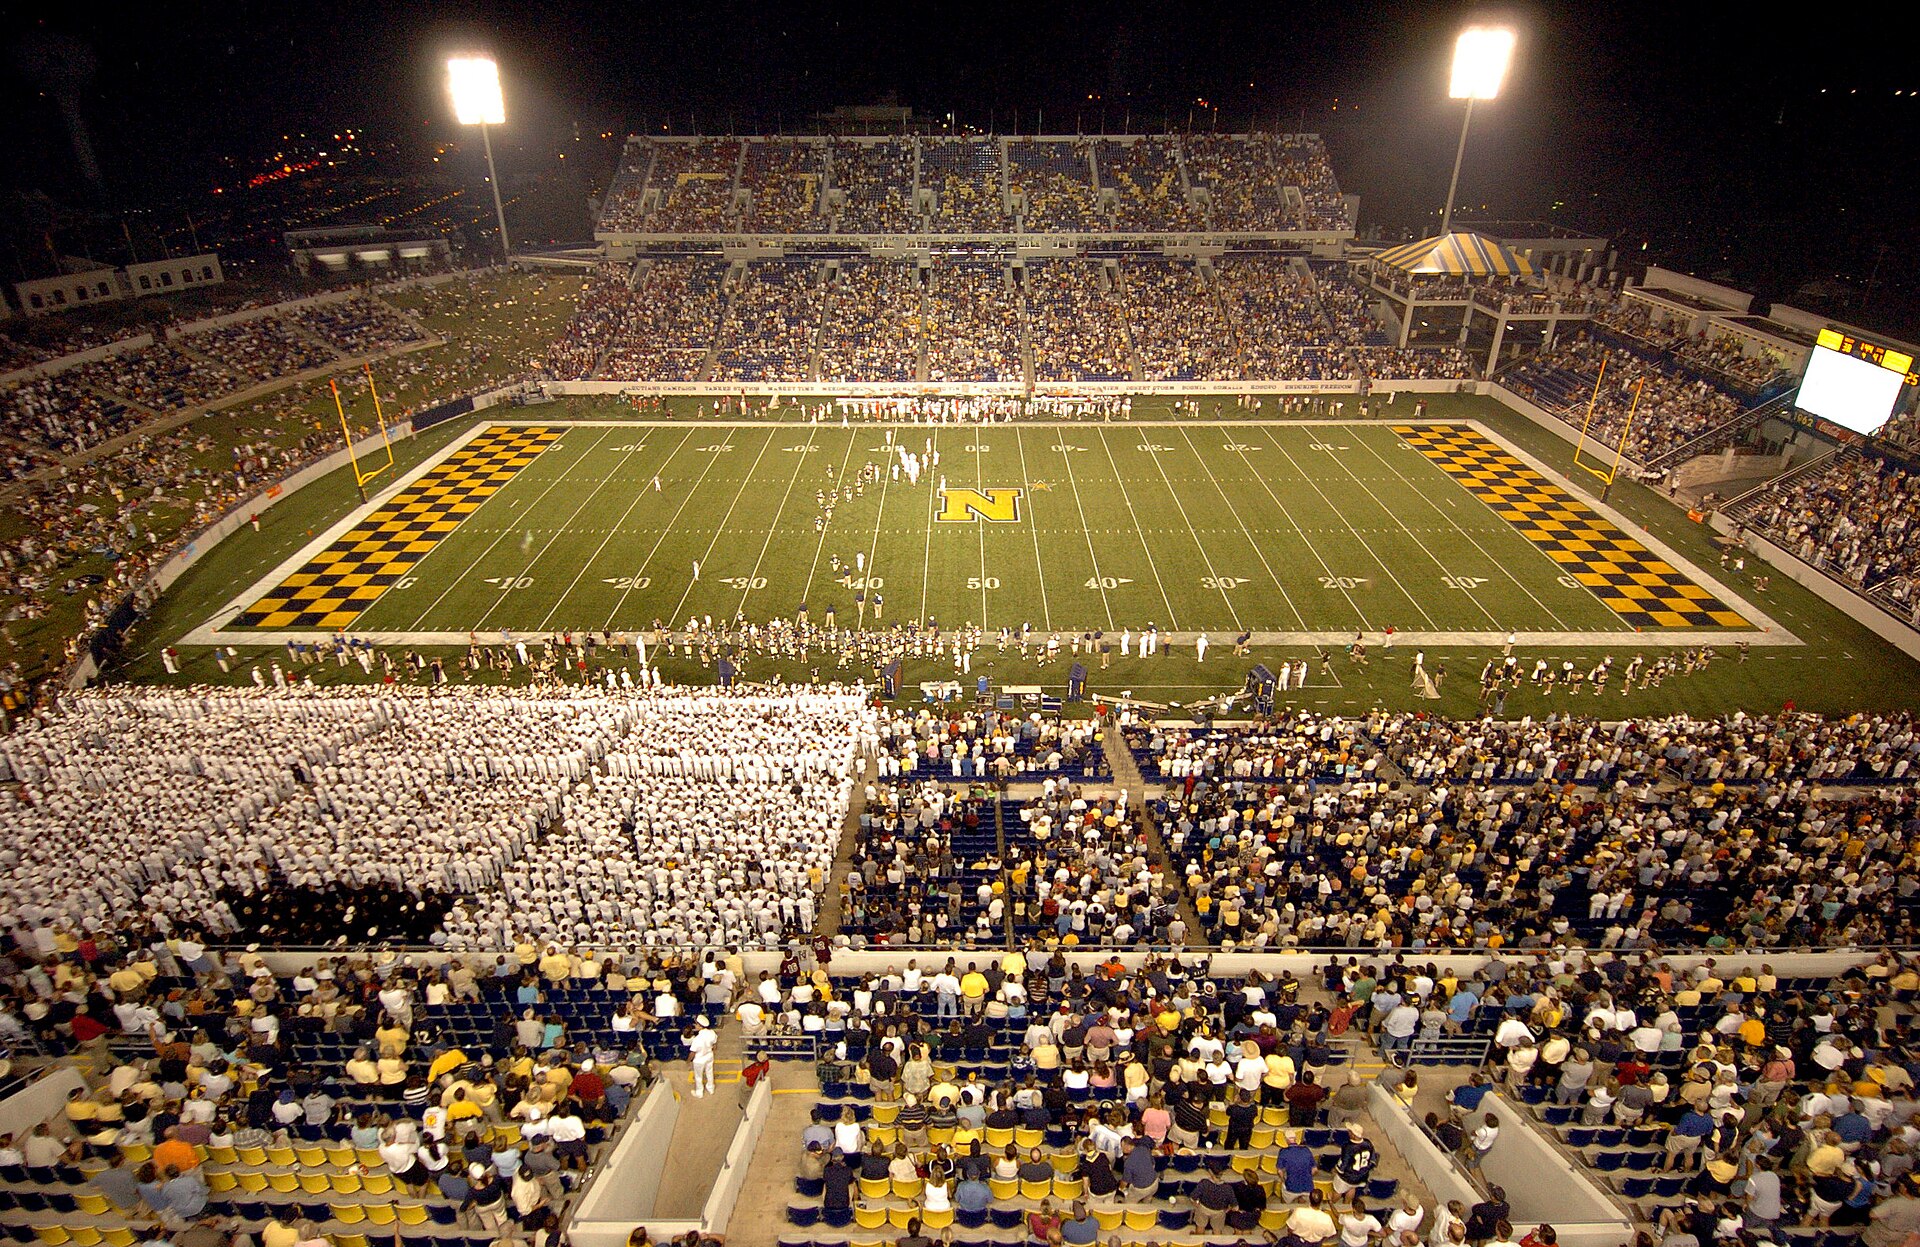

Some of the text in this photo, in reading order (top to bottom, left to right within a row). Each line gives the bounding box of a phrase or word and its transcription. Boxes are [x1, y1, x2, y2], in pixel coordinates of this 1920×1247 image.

[1904, 372, 1919, 386] 25
[934, 487, 1024, 523] N
[497, 576, 535, 590] 10
[613, 576, 652, 590] 20
[731, 576, 769, 590] 30
[848, 576, 885, 590] 40
[966, 577, 1000, 590] 50
[1084, 576, 1118, 590] 40
[1200, 576, 1237, 590] 30
[1317, 576, 1357, 590] 20
[1440, 576, 1478, 590] 10
[1556, 576, 1580, 590] G
[413, 1030, 432, 1044] 12
